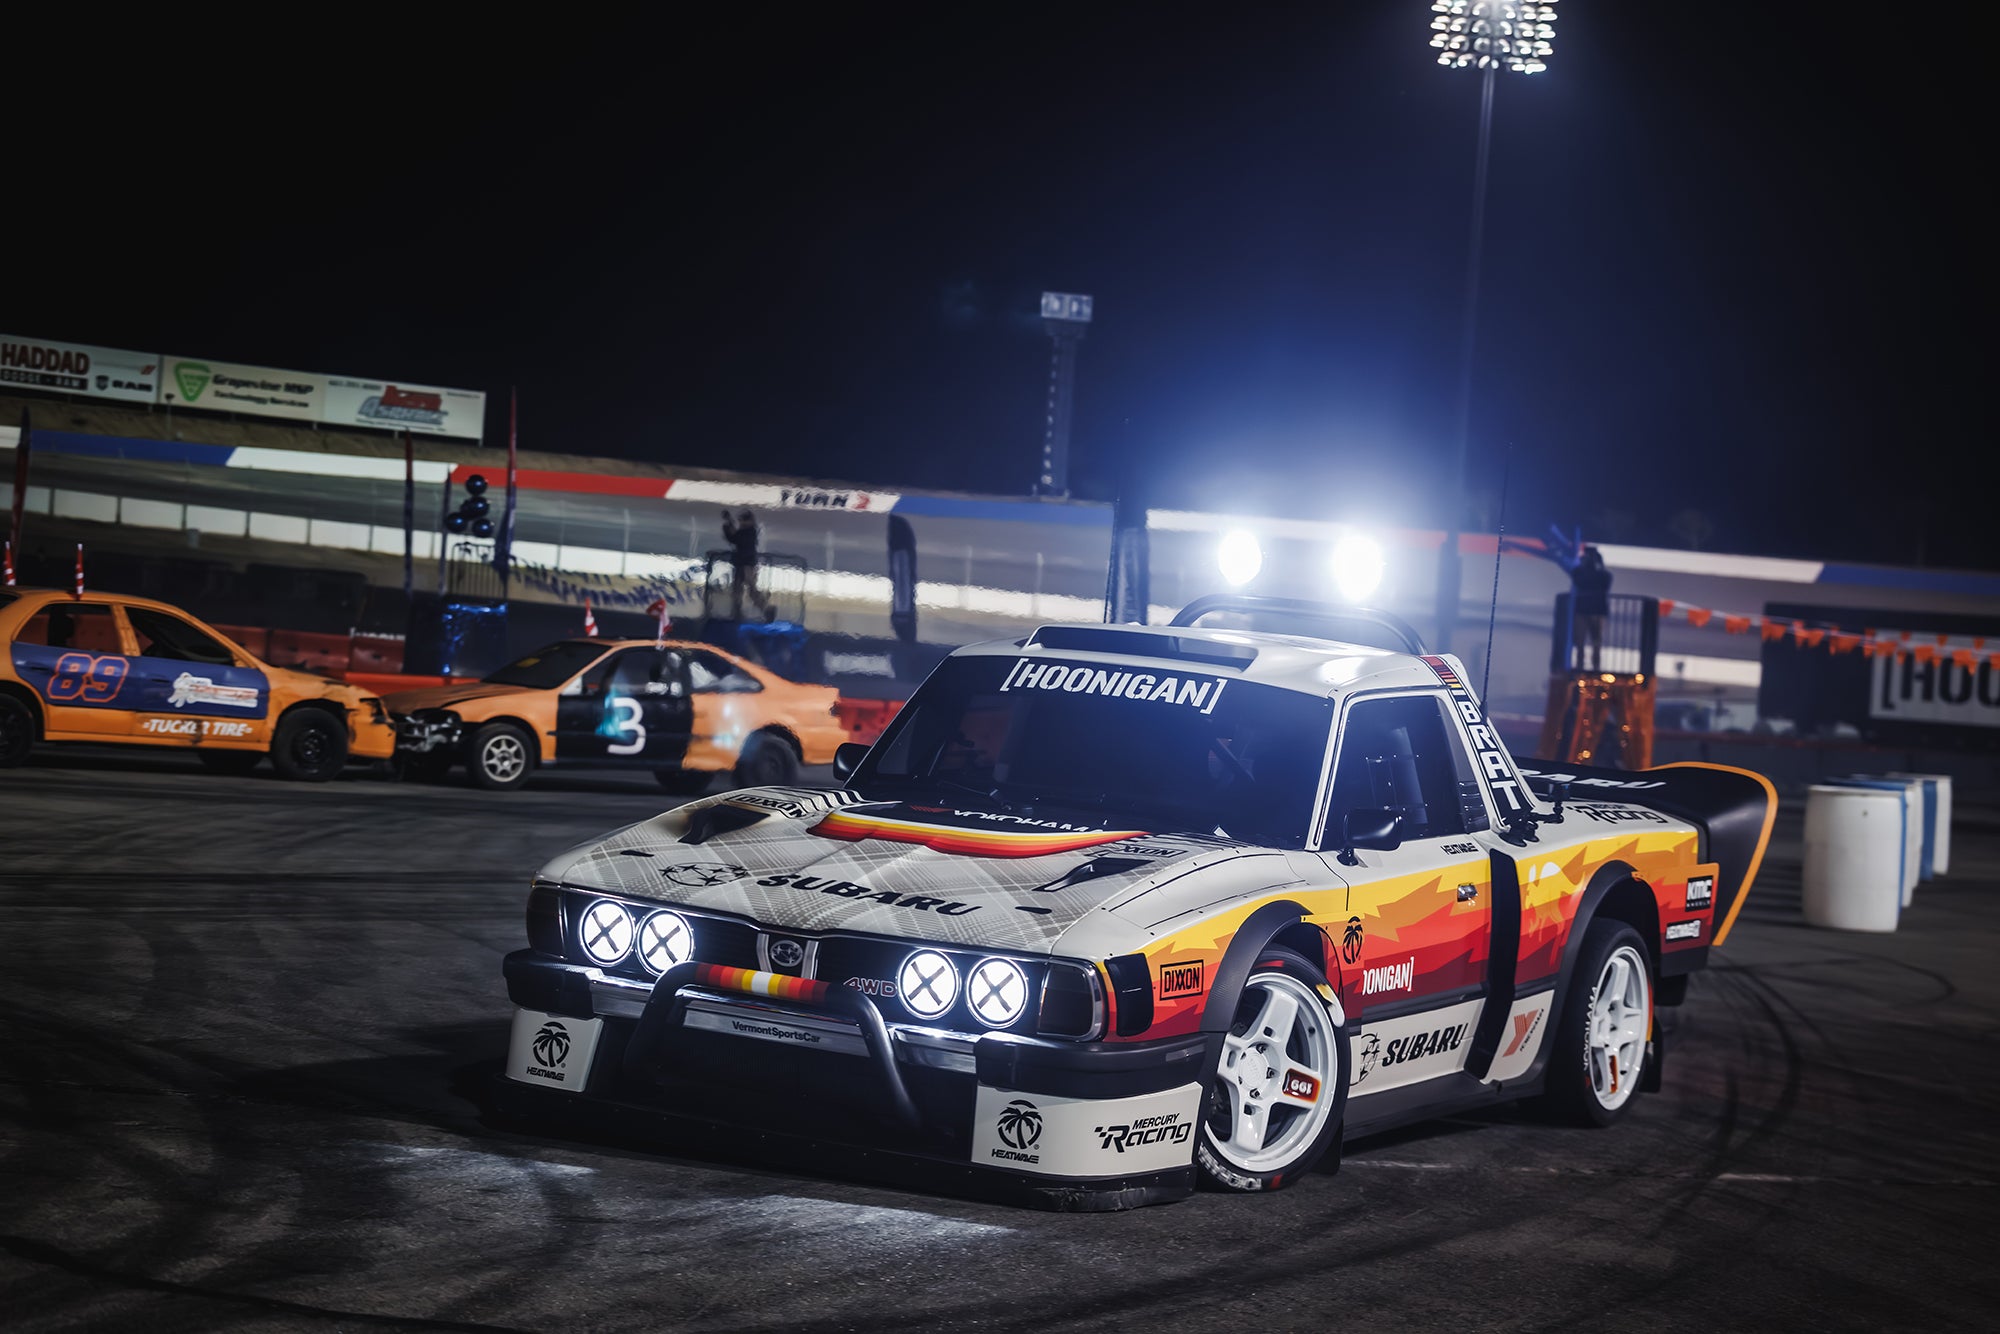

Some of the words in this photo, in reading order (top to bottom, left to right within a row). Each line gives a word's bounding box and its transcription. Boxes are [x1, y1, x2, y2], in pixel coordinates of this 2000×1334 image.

[1, 343, 90, 375] HADDAD
[112, 380, 152, 392] RAM
[855, 490, 870, 509] 2
[46, 652, 130, 703] 89
[1000, 657, 1228, 715] [HOONIGAN]
[608, 697, 647, 754] 3
[1457, 701, 1522, 811] BRAT
[757, 874, 982, 916] SUBARU
[1687, 879, 1712, 901] KMC
[843, 976, 897, 998] 4WD
[1163, 967, 1200, 993] DIXXON
[732, 1020, 821, 1044] VermontSportsCar
[1382, 1022, 1469, 1067] SUBARU
[1132, 1112, 1180, 1130] MERCURY
[1101, 1122, 1192, 1153] Racing
[991, 1149, 1039, 1165] HEATWAVE
